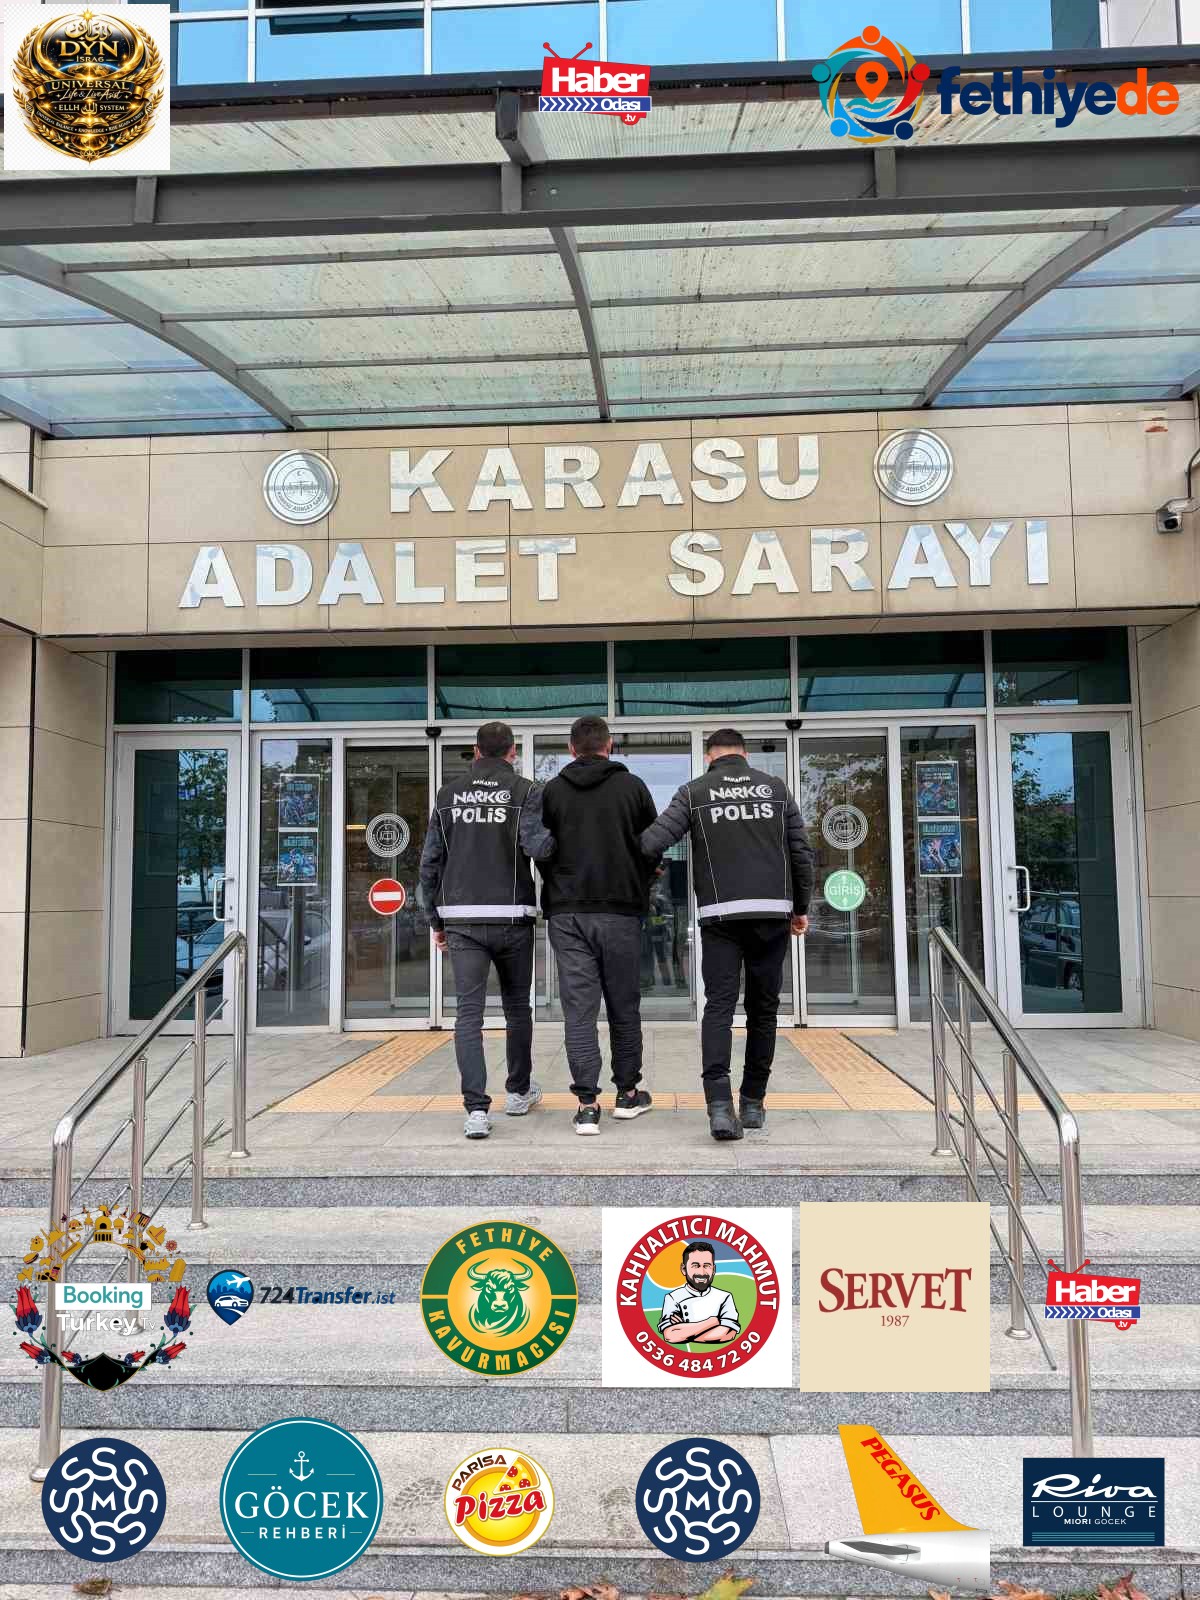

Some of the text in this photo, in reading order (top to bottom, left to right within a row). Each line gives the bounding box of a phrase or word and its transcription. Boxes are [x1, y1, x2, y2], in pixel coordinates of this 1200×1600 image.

[389, 434, 820, 513] KARASU
[178, 520, 1049, 608] ADALET SARAYI
